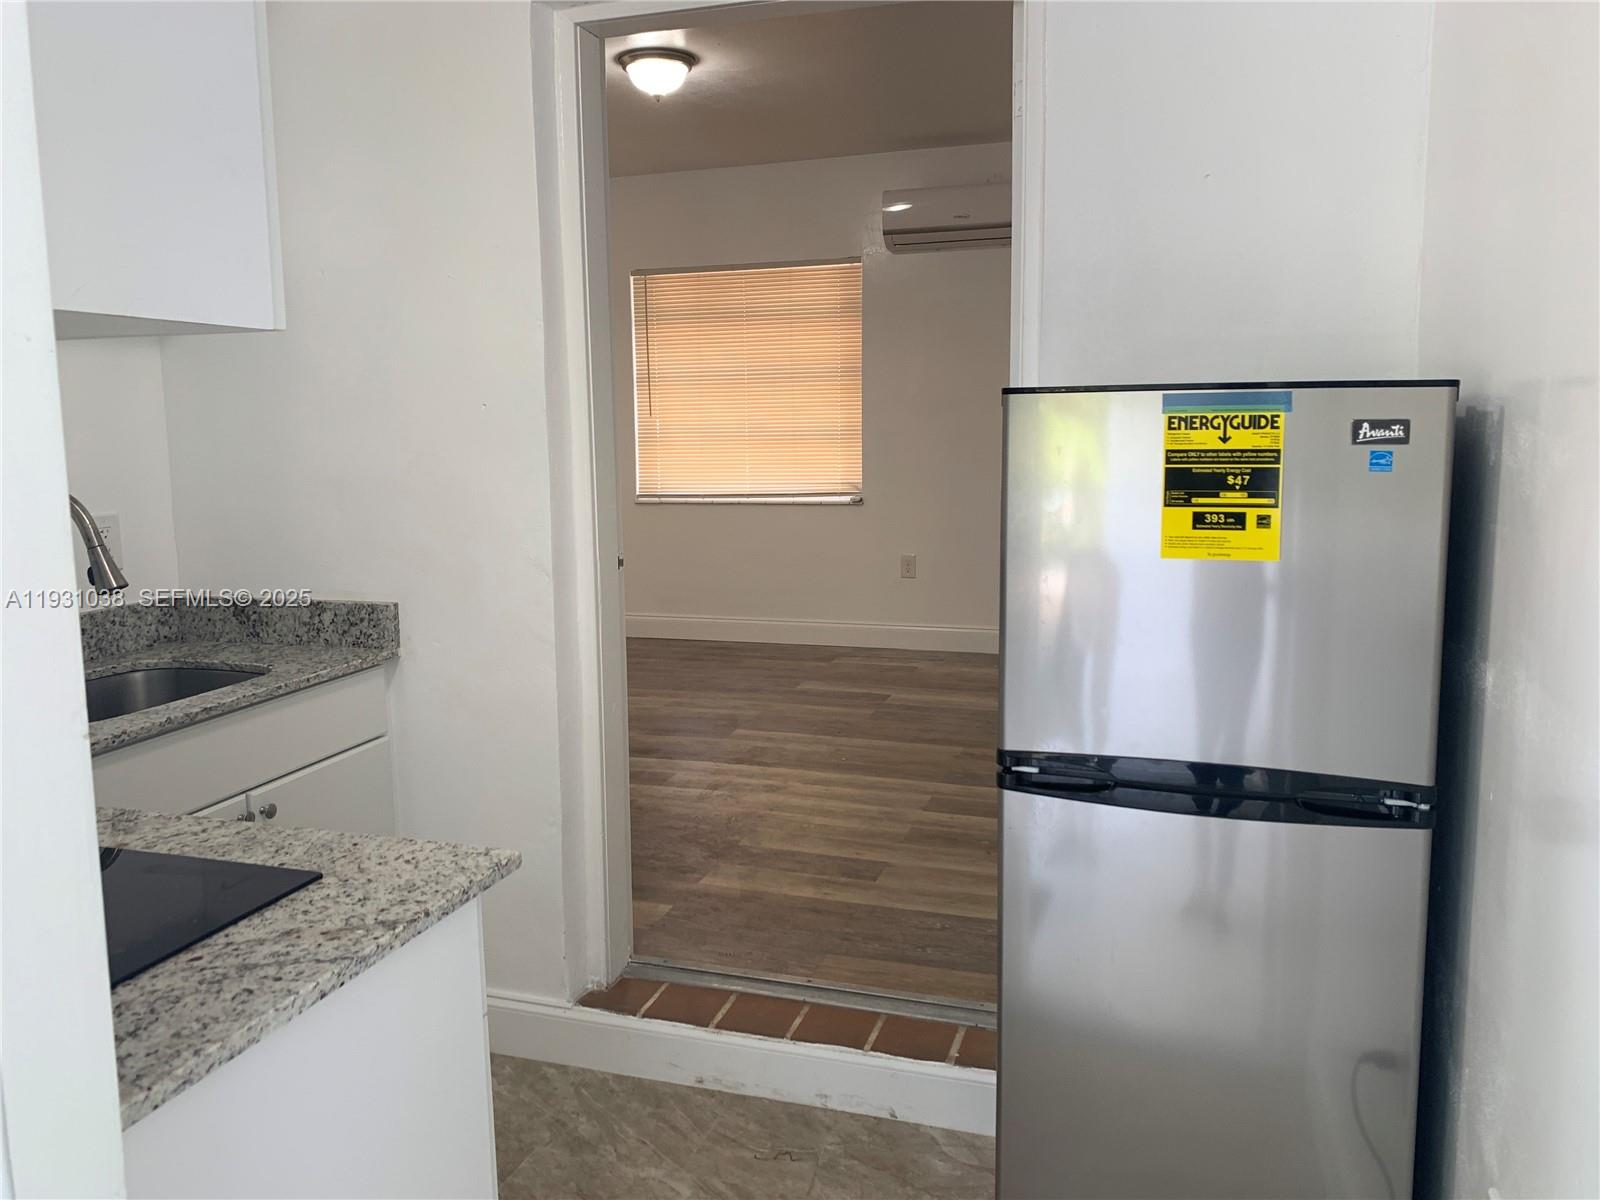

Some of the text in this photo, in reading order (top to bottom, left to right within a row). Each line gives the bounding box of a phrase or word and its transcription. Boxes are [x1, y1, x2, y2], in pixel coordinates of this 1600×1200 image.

[1167, 414, 1280, 430] ENERGYGUIDE
[1358, 422, 1405, 440] Avanti
[1227, 475, 1250, 485] $47
[1204, 513, 1225, 523] 393
